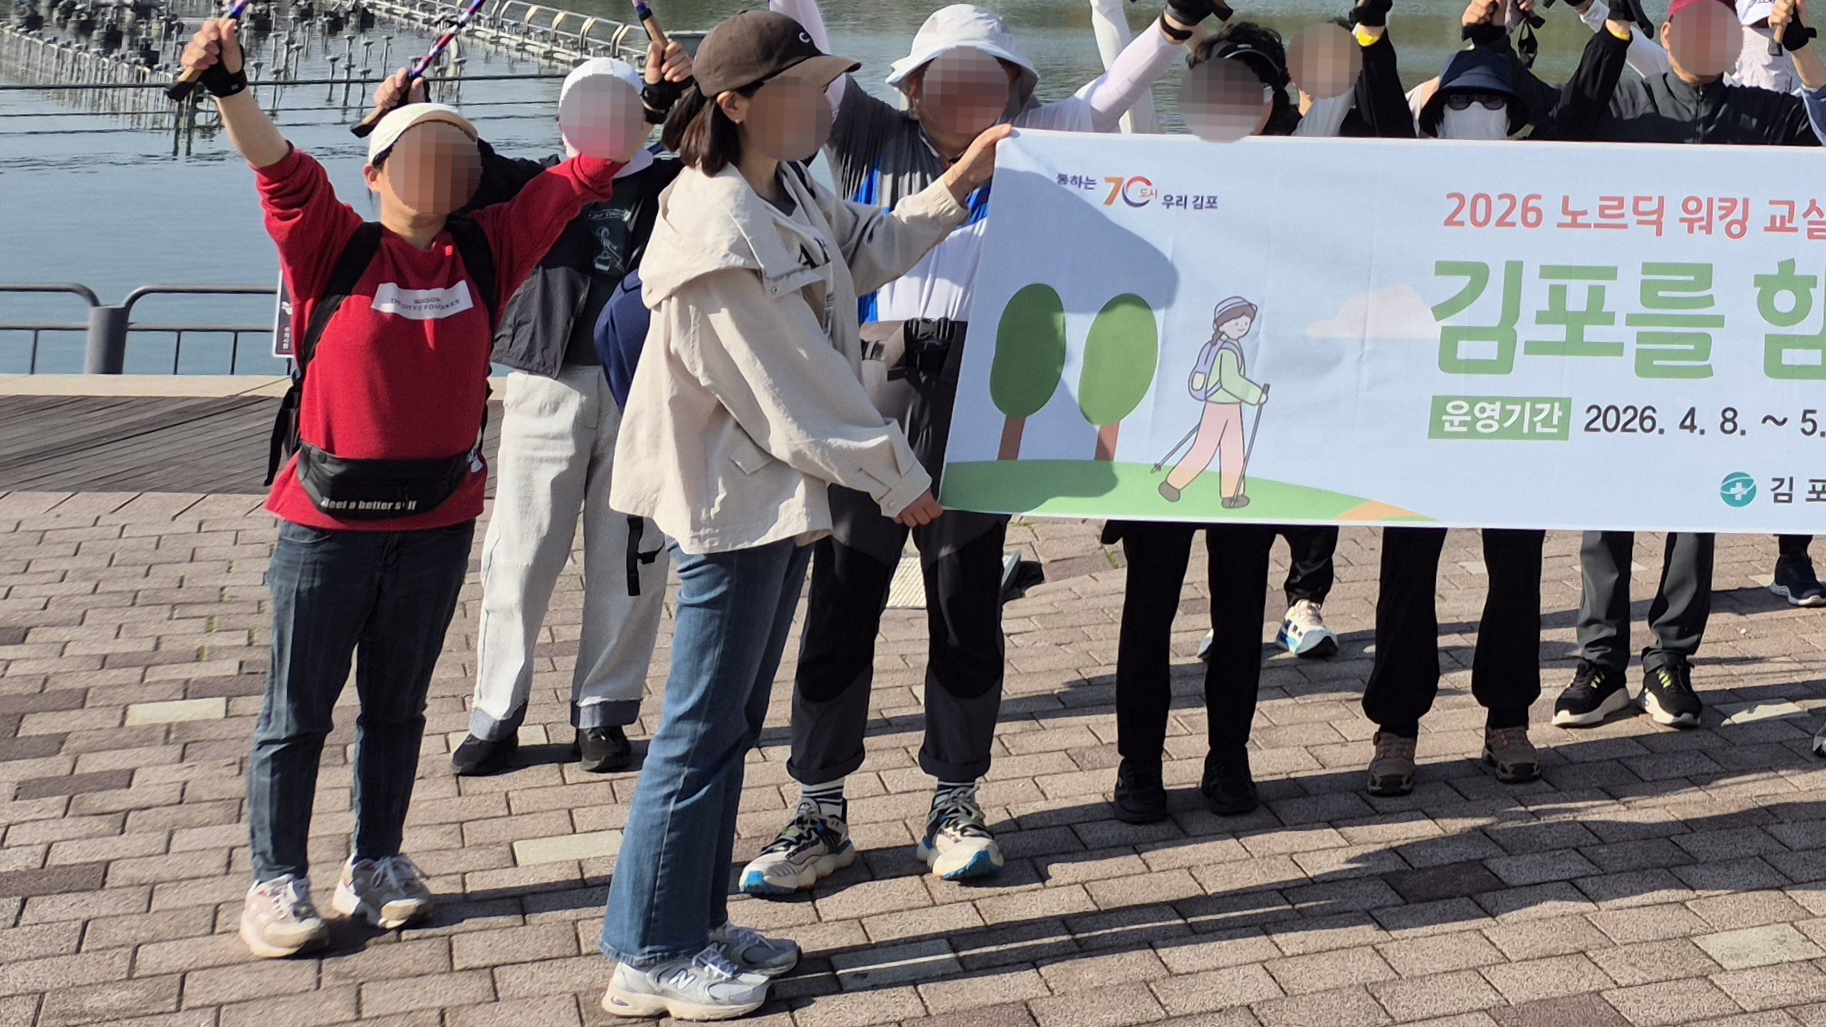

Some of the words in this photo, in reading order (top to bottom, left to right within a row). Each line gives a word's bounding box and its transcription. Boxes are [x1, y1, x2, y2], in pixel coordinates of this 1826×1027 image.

[1056, 173, 1097, 191] 통하는
[1161, 194, 1188, 210] 우리
[1192, 195, 1219, 210] 김포
[1443, 192, 1544, 229] 2026
[1556, 194, 1666, 237] 노르딕
[1679, 195, 1749, 240] 워킹
[1430, 259, 1726, 380] 김포를
[1441, 399, 1563, 435] 운영기간
[1583, 404, 1665, 436] 2026.
[1678, 406, 1706, 436] 4.
[1719, 406, 1747, 437] 8.
[1799, 408, 1826, 438] 5.
[358, 501, 393, 510] better
[395, 501, 417, 510] slf
